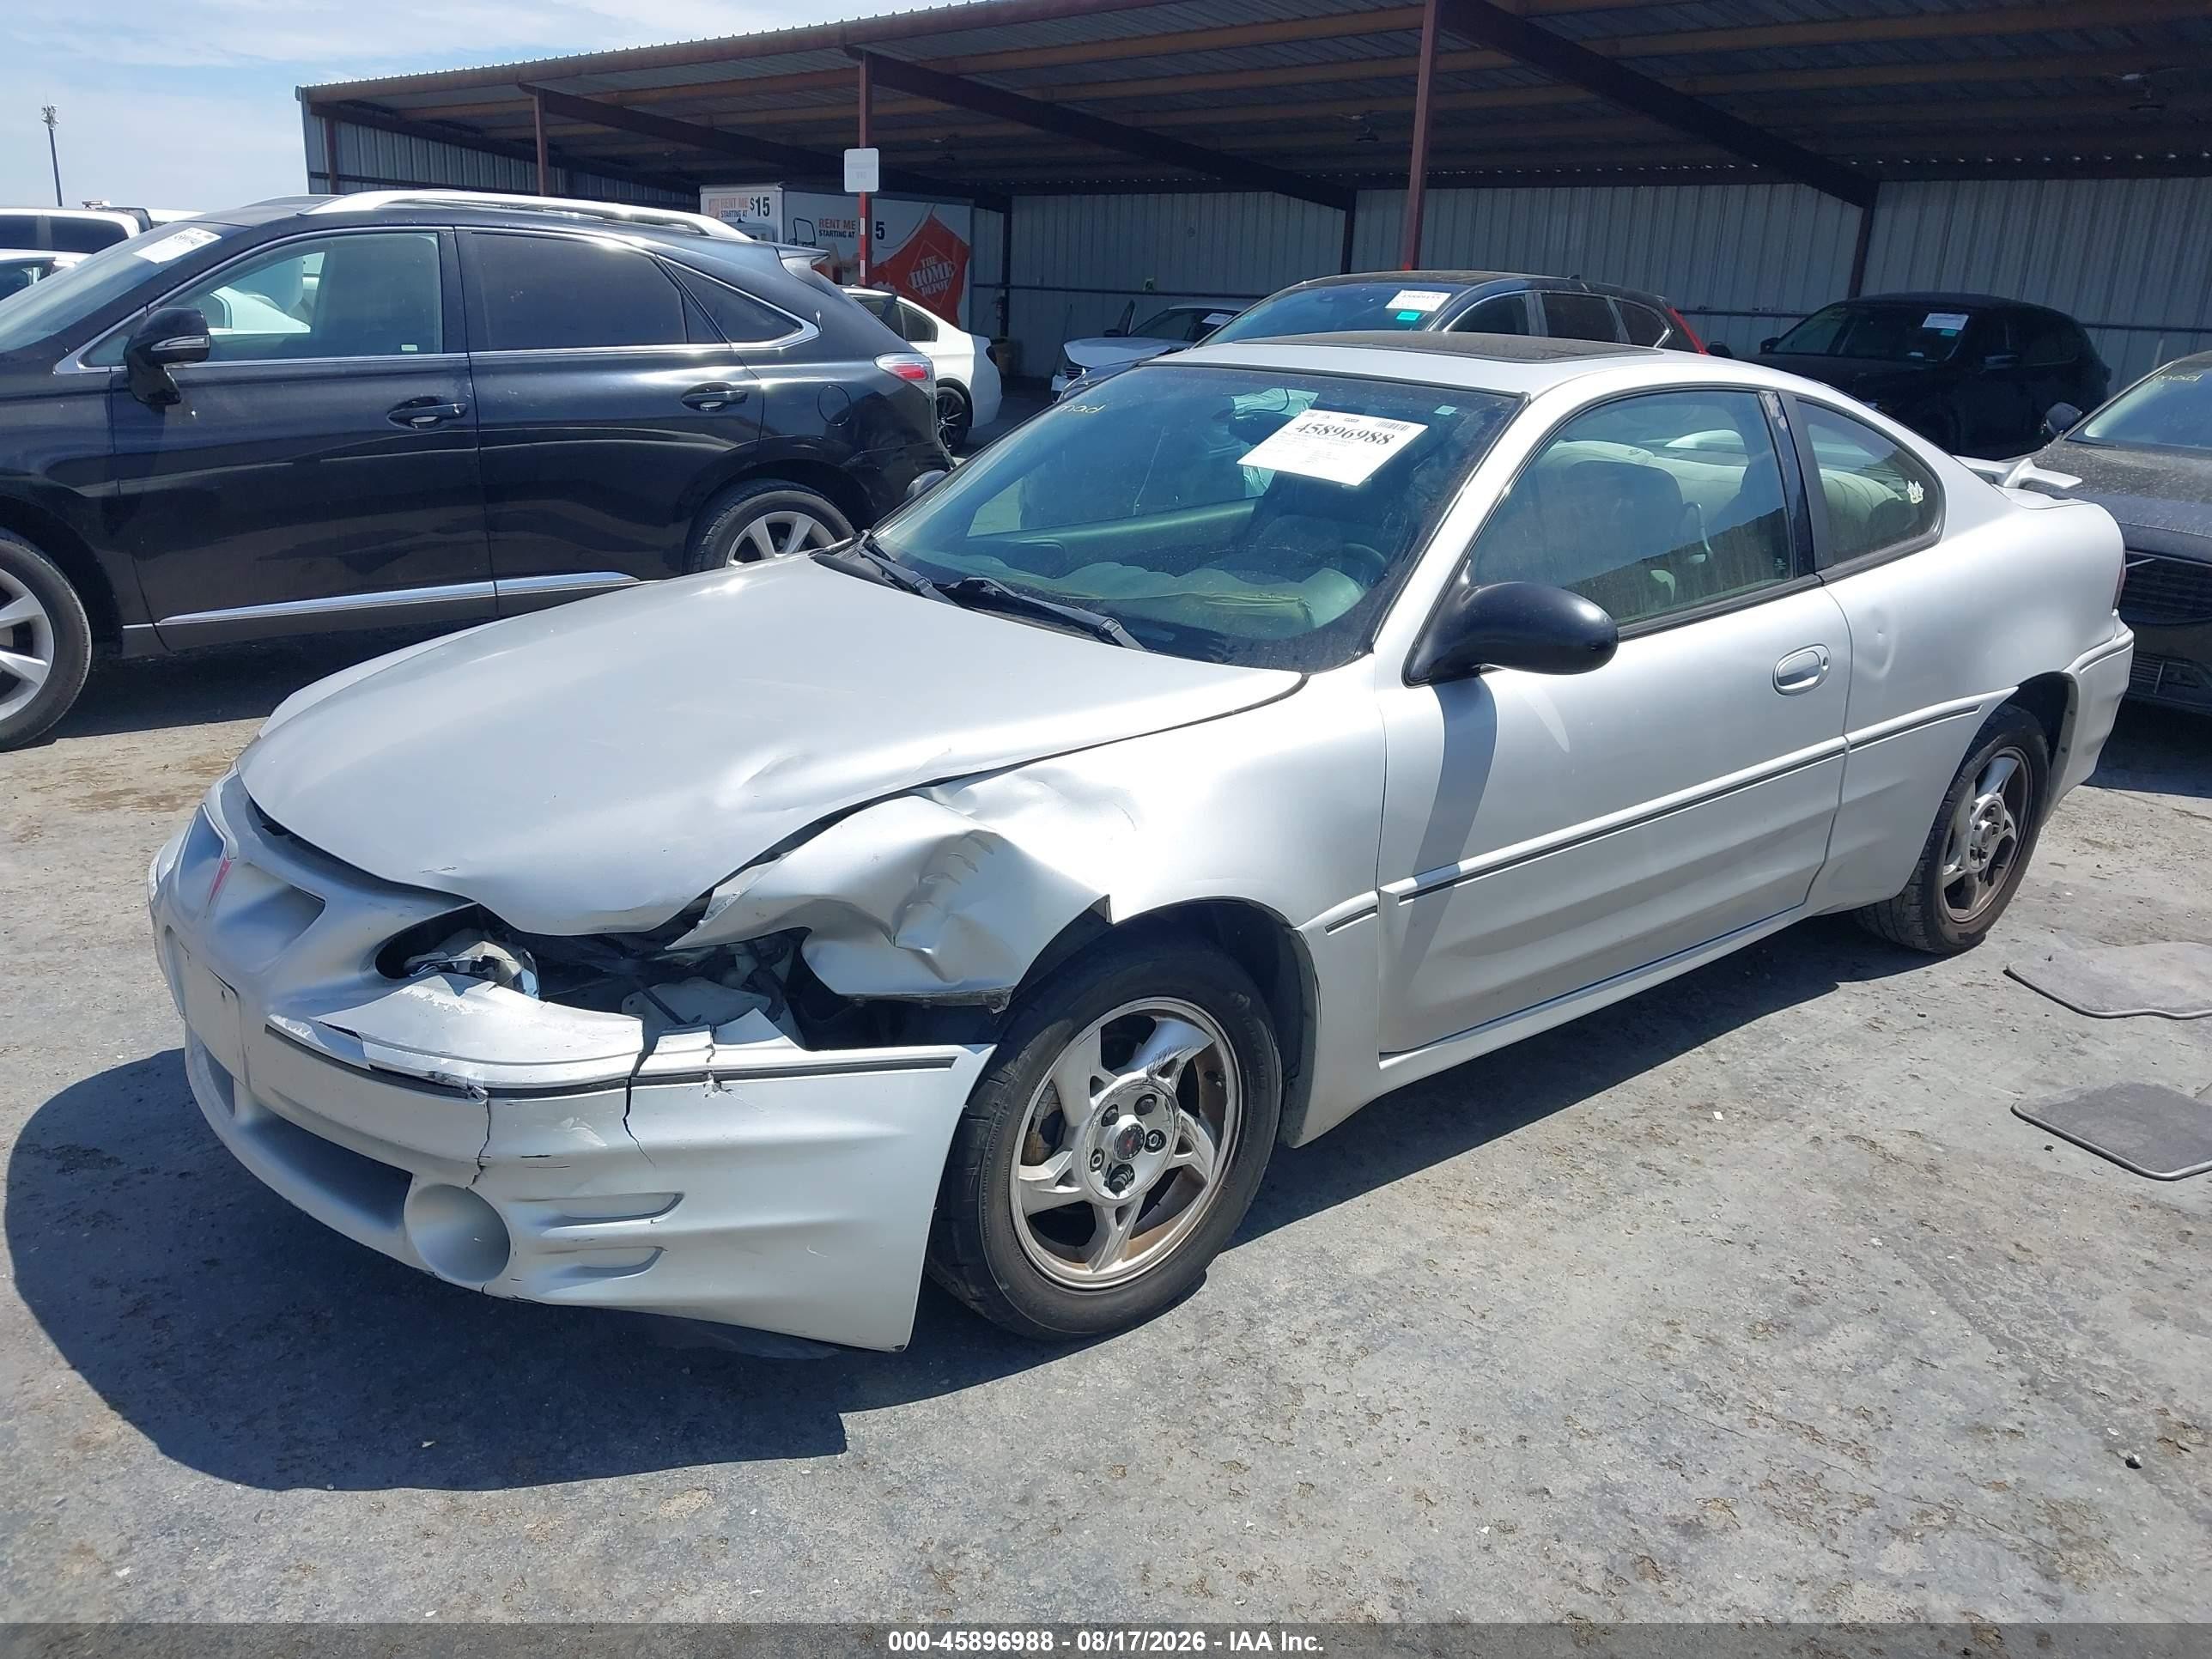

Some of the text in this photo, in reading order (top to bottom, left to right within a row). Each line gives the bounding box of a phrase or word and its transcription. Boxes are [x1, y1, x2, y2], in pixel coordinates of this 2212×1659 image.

[750, 196, 770, 217] $15
[818, 219, 839, 229] RENT
[843, 220, 855, 230] ME
[818, 229, 847, 238] STARTING
[921, 255, 937, 269] THE
[909, 260, 955, 289] HOME
[920, 279, 950, 296] DEPOT
[1295, 422, 1395, 445] 45896988
